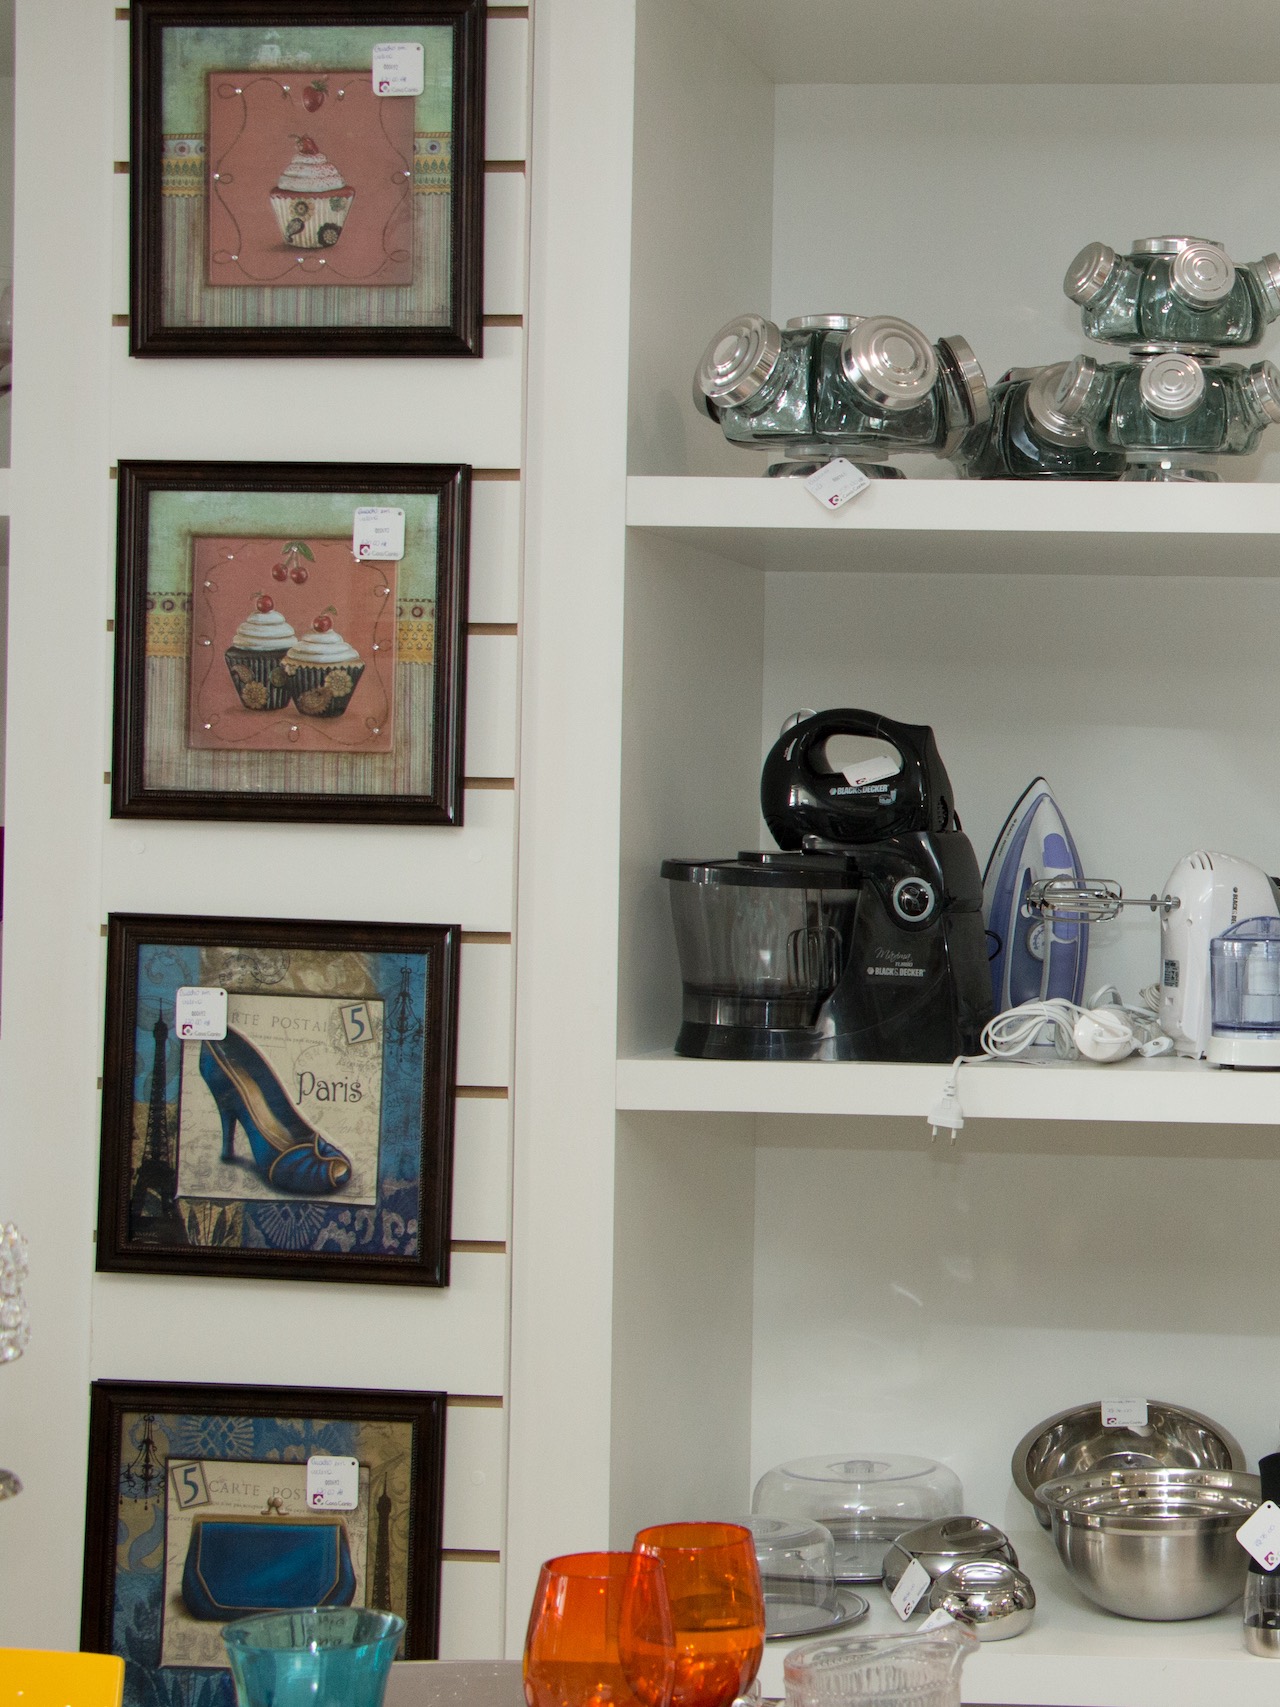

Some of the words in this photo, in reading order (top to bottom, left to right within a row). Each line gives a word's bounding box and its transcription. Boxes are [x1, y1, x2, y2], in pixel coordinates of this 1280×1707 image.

[1231, 893, 1239, 925] BLACK&DE
[875, 967, 925, 977] BLACK&DECKER
[231, 1012, 261, 1027] RTE
[351, 1007, 365, 1042] 5
[296, 1071, 363, 1106] Paris
[183, 1466, 199, 1505] 5
[208, 1480, 261, 1497] CARTE
[272, 1486, 307, 1501] POST
